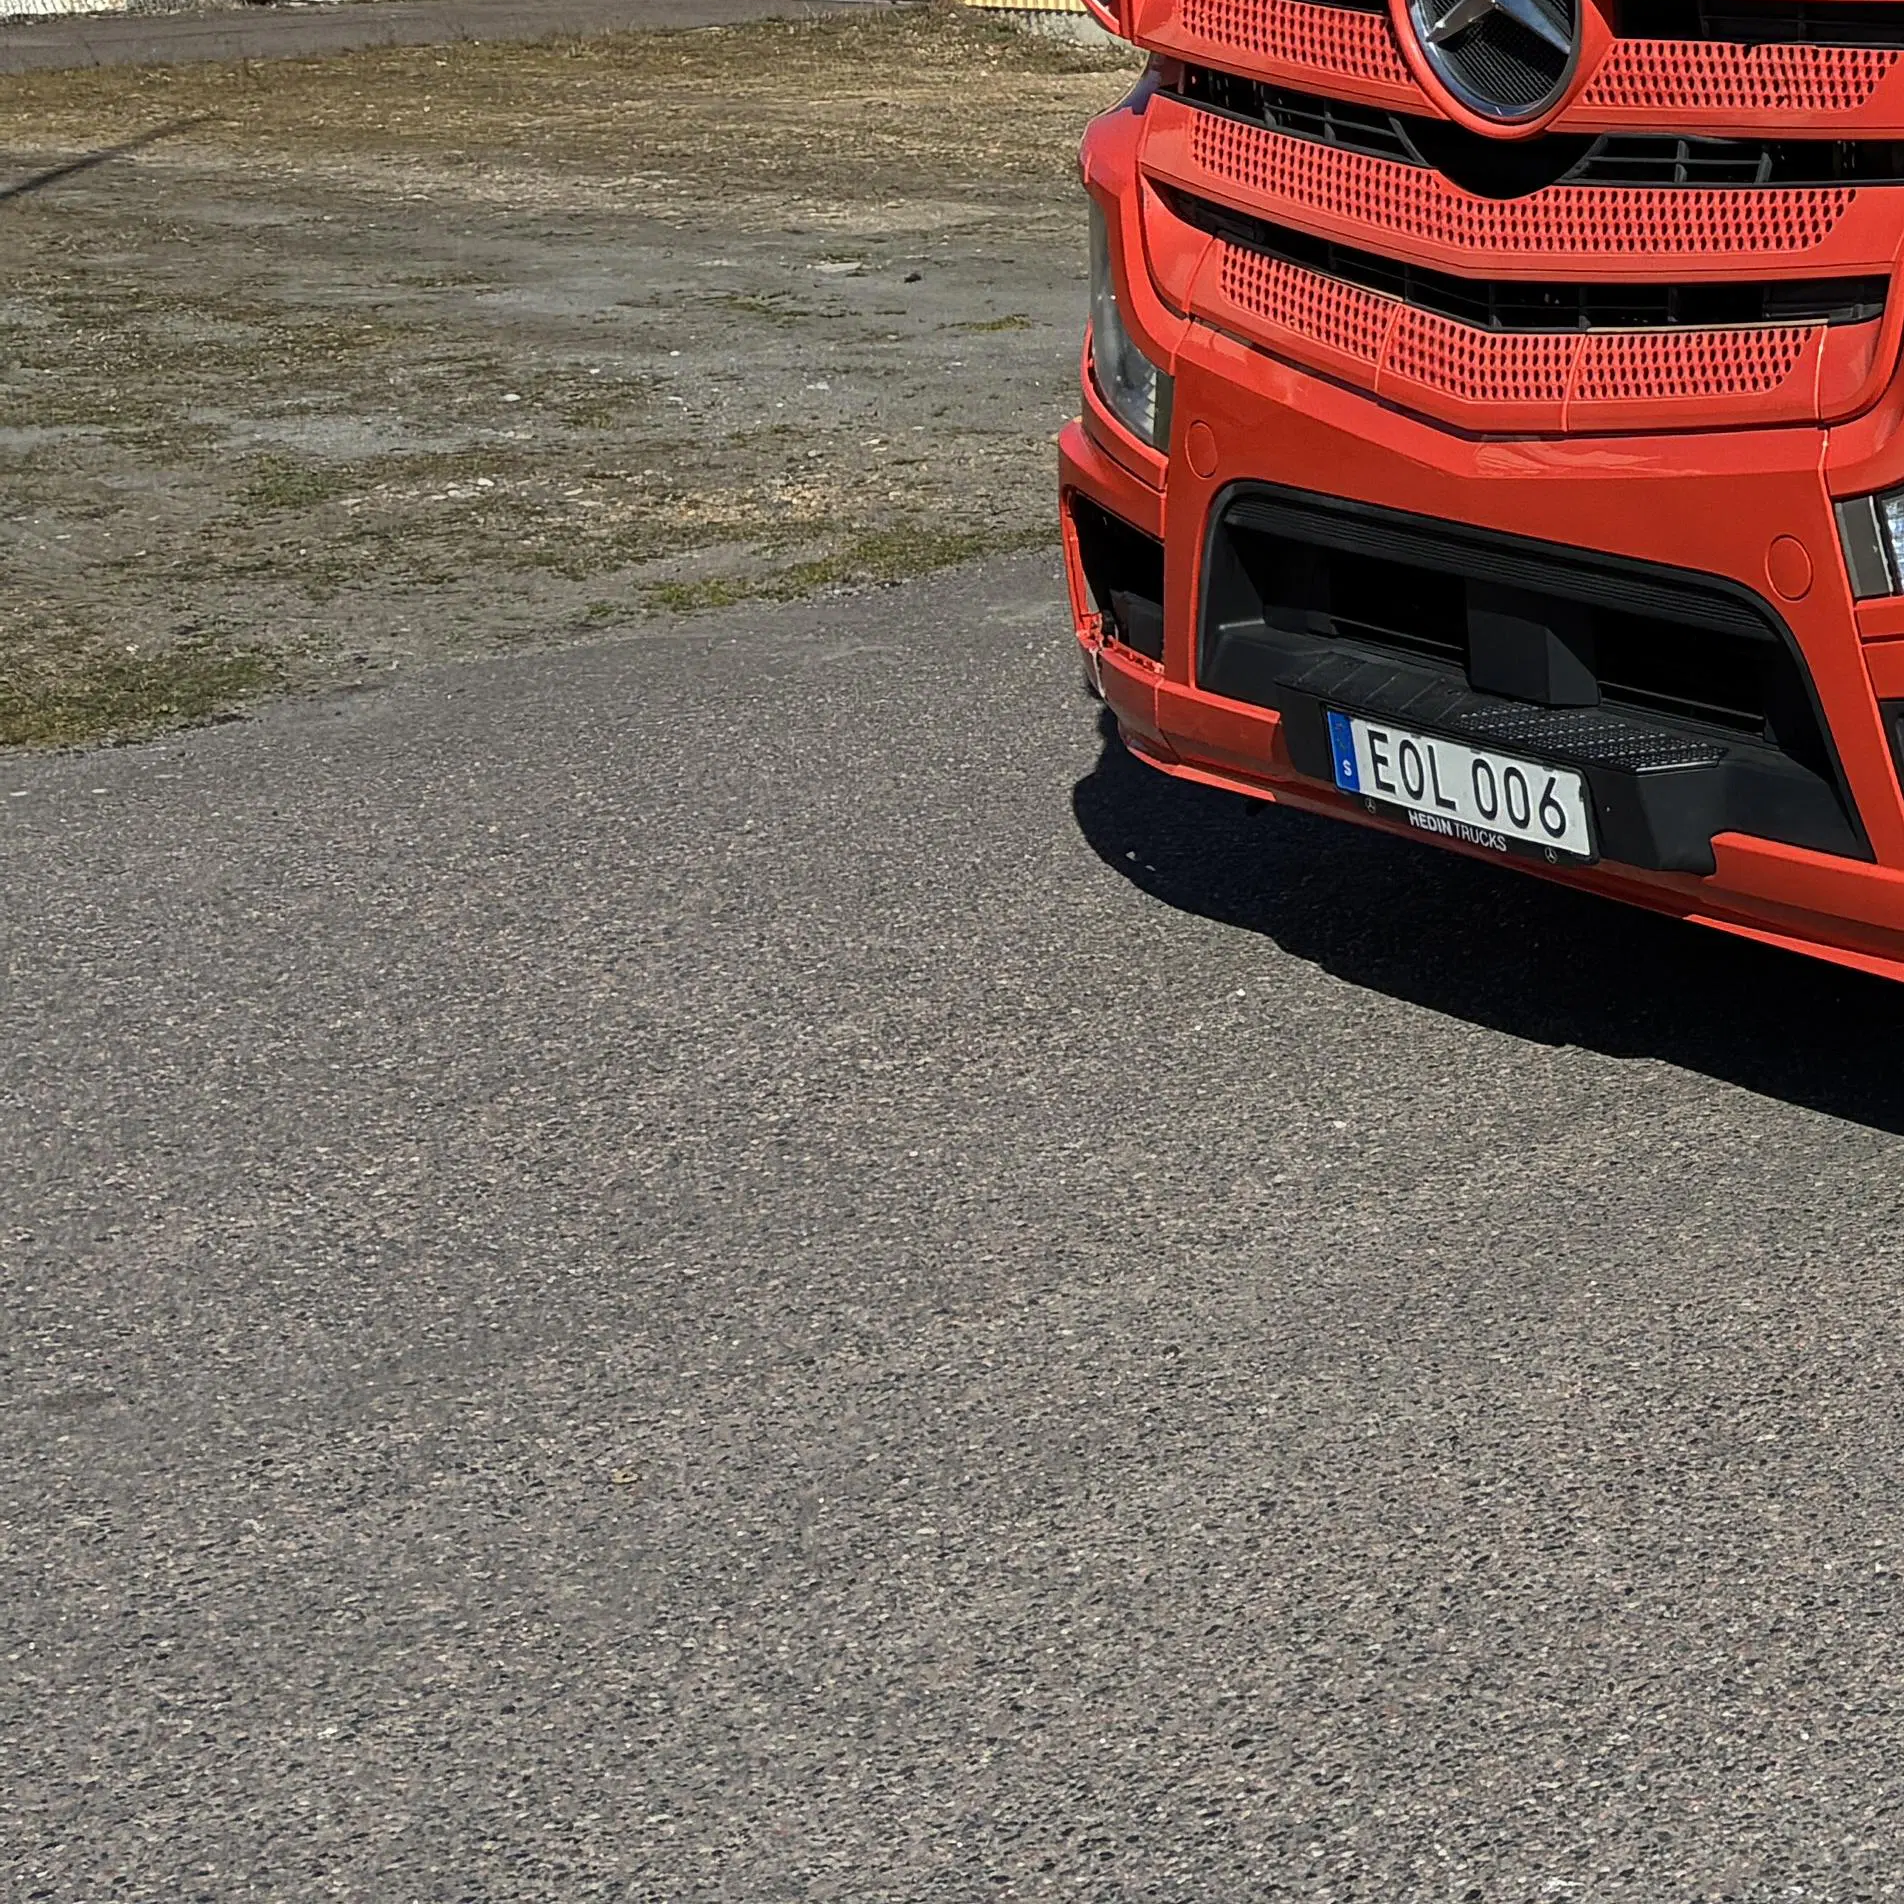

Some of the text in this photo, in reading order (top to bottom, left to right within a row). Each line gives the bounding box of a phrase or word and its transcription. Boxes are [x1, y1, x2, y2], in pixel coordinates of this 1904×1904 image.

[1342, 728, 1567, 840] S EOL 006
[1409, 809, 1508, 853] HEDIN TRUCKS
